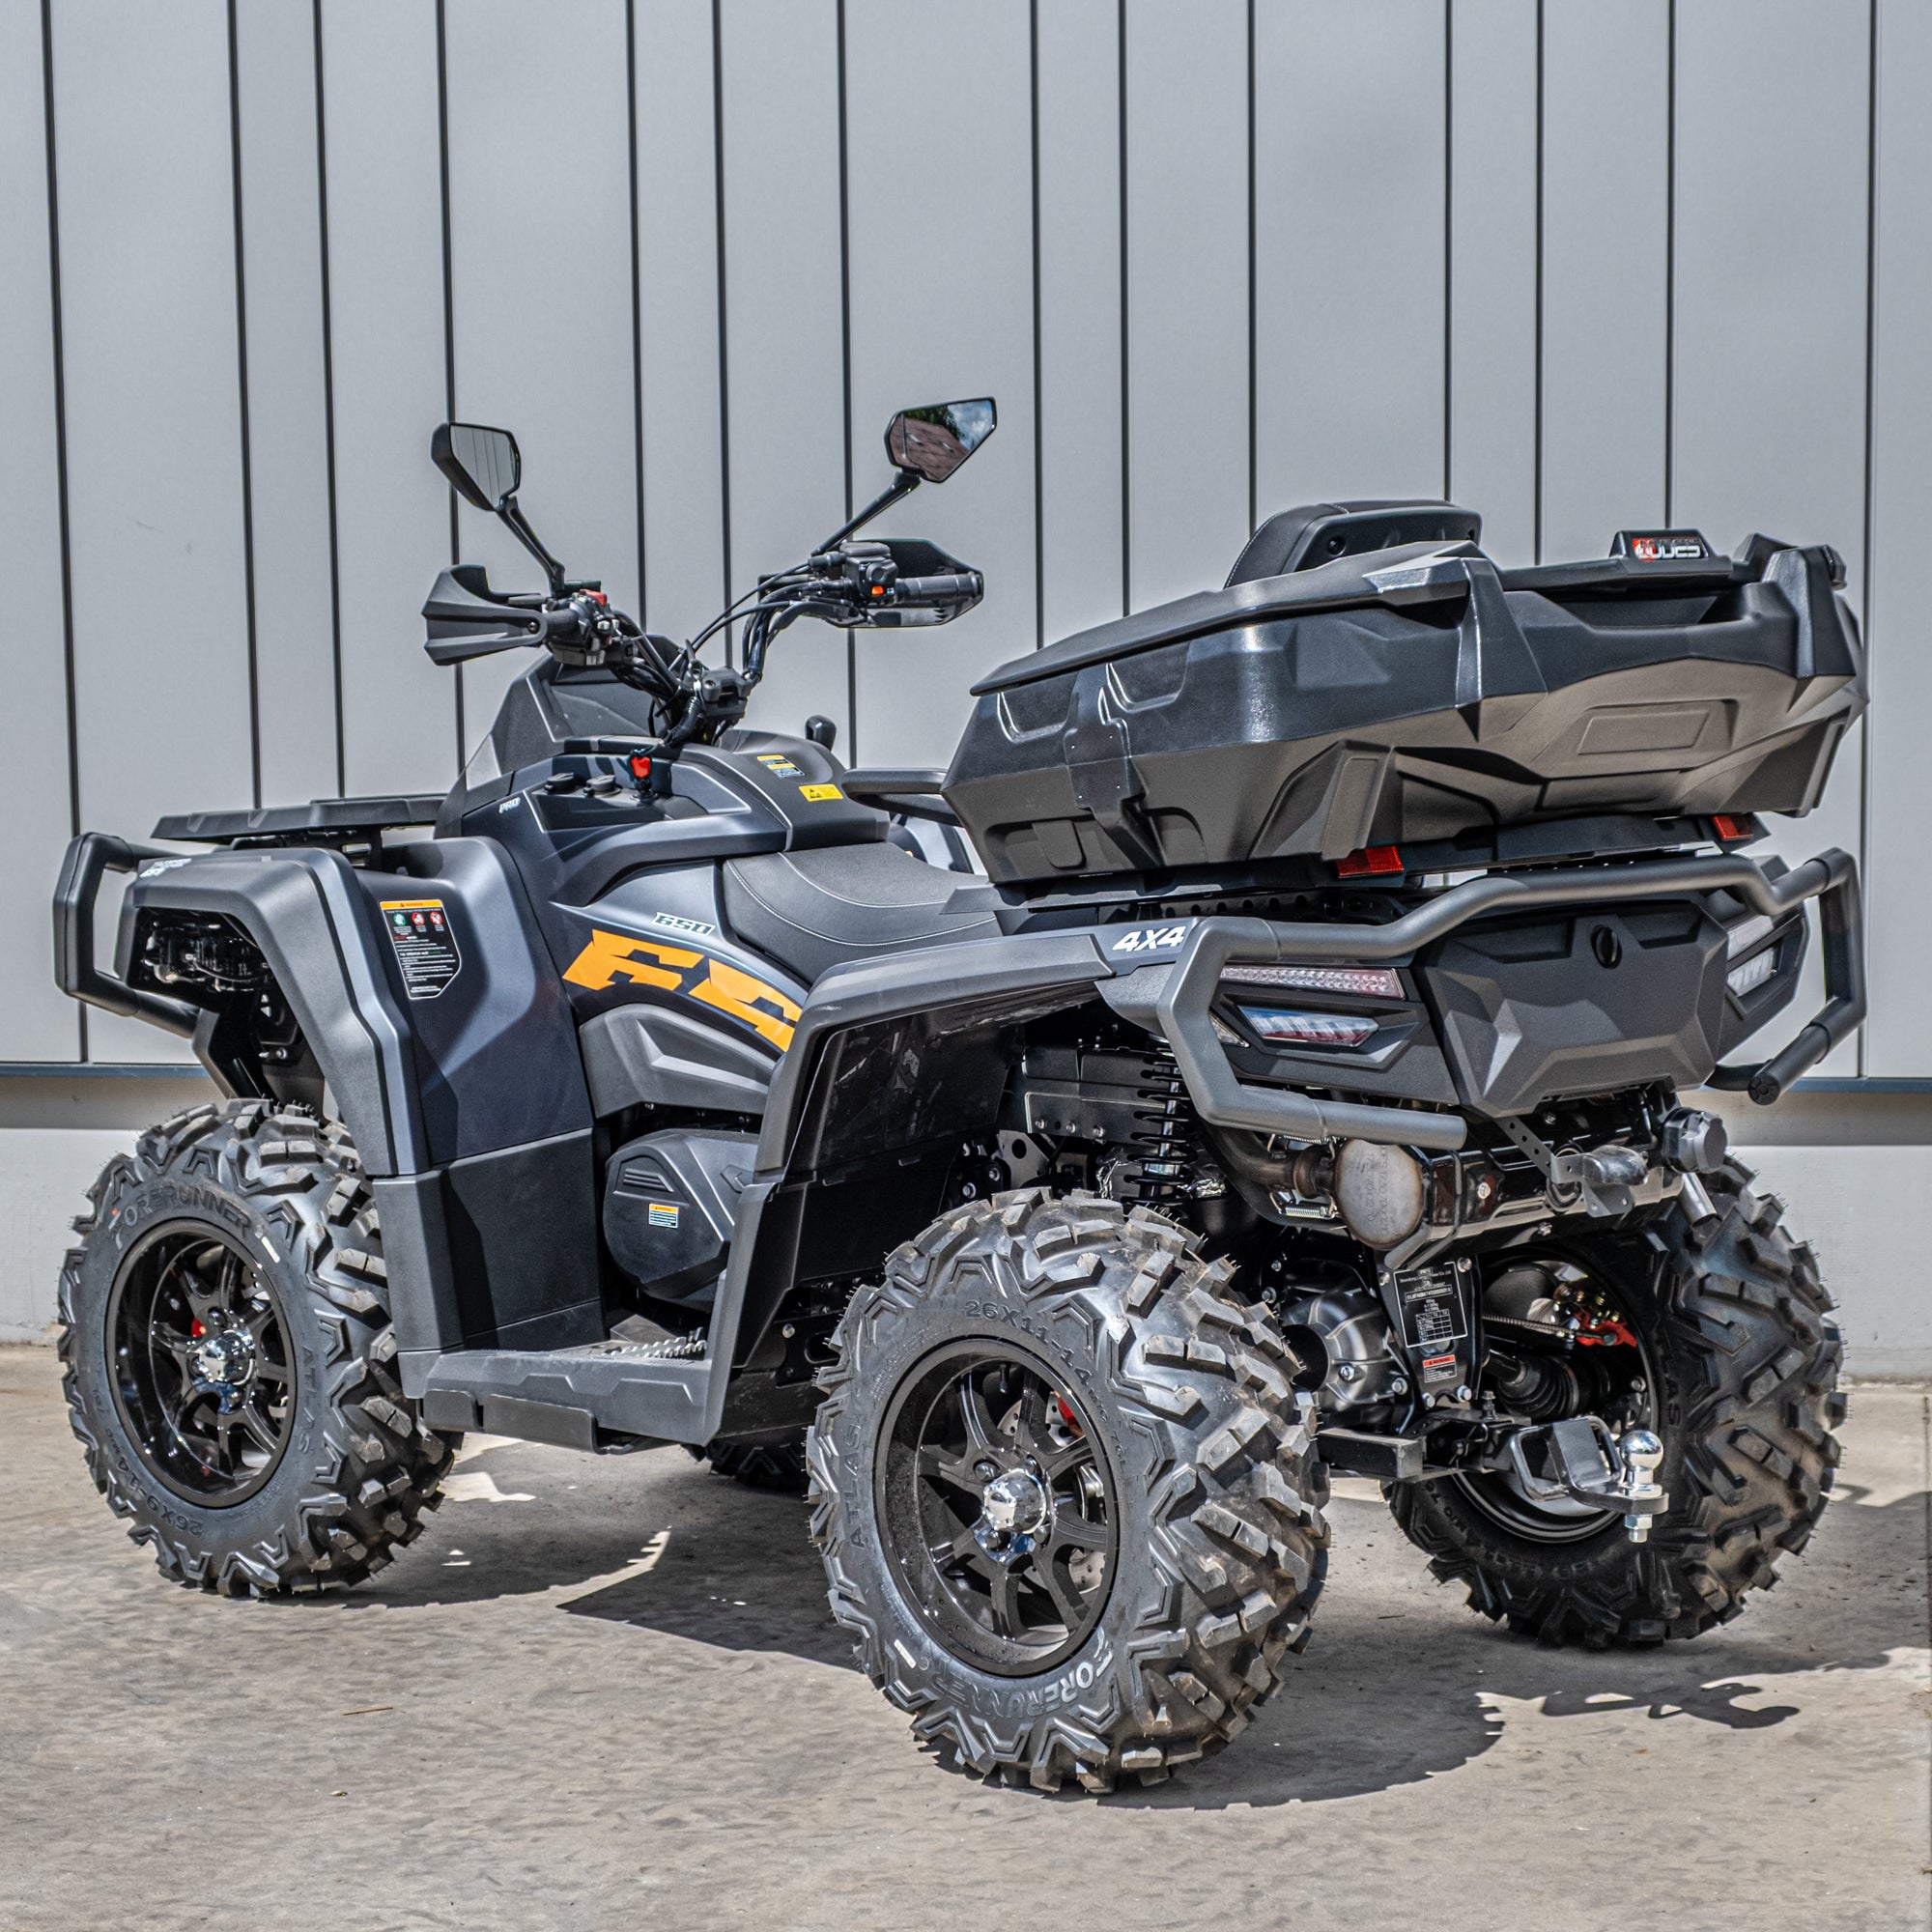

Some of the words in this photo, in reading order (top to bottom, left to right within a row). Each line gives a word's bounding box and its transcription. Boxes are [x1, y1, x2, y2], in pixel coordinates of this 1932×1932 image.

[652, 911, 716, 935] 650
[1112, 925, 1186, 952] 4X4
[842, 1423, 867, 1549] ATLAS
